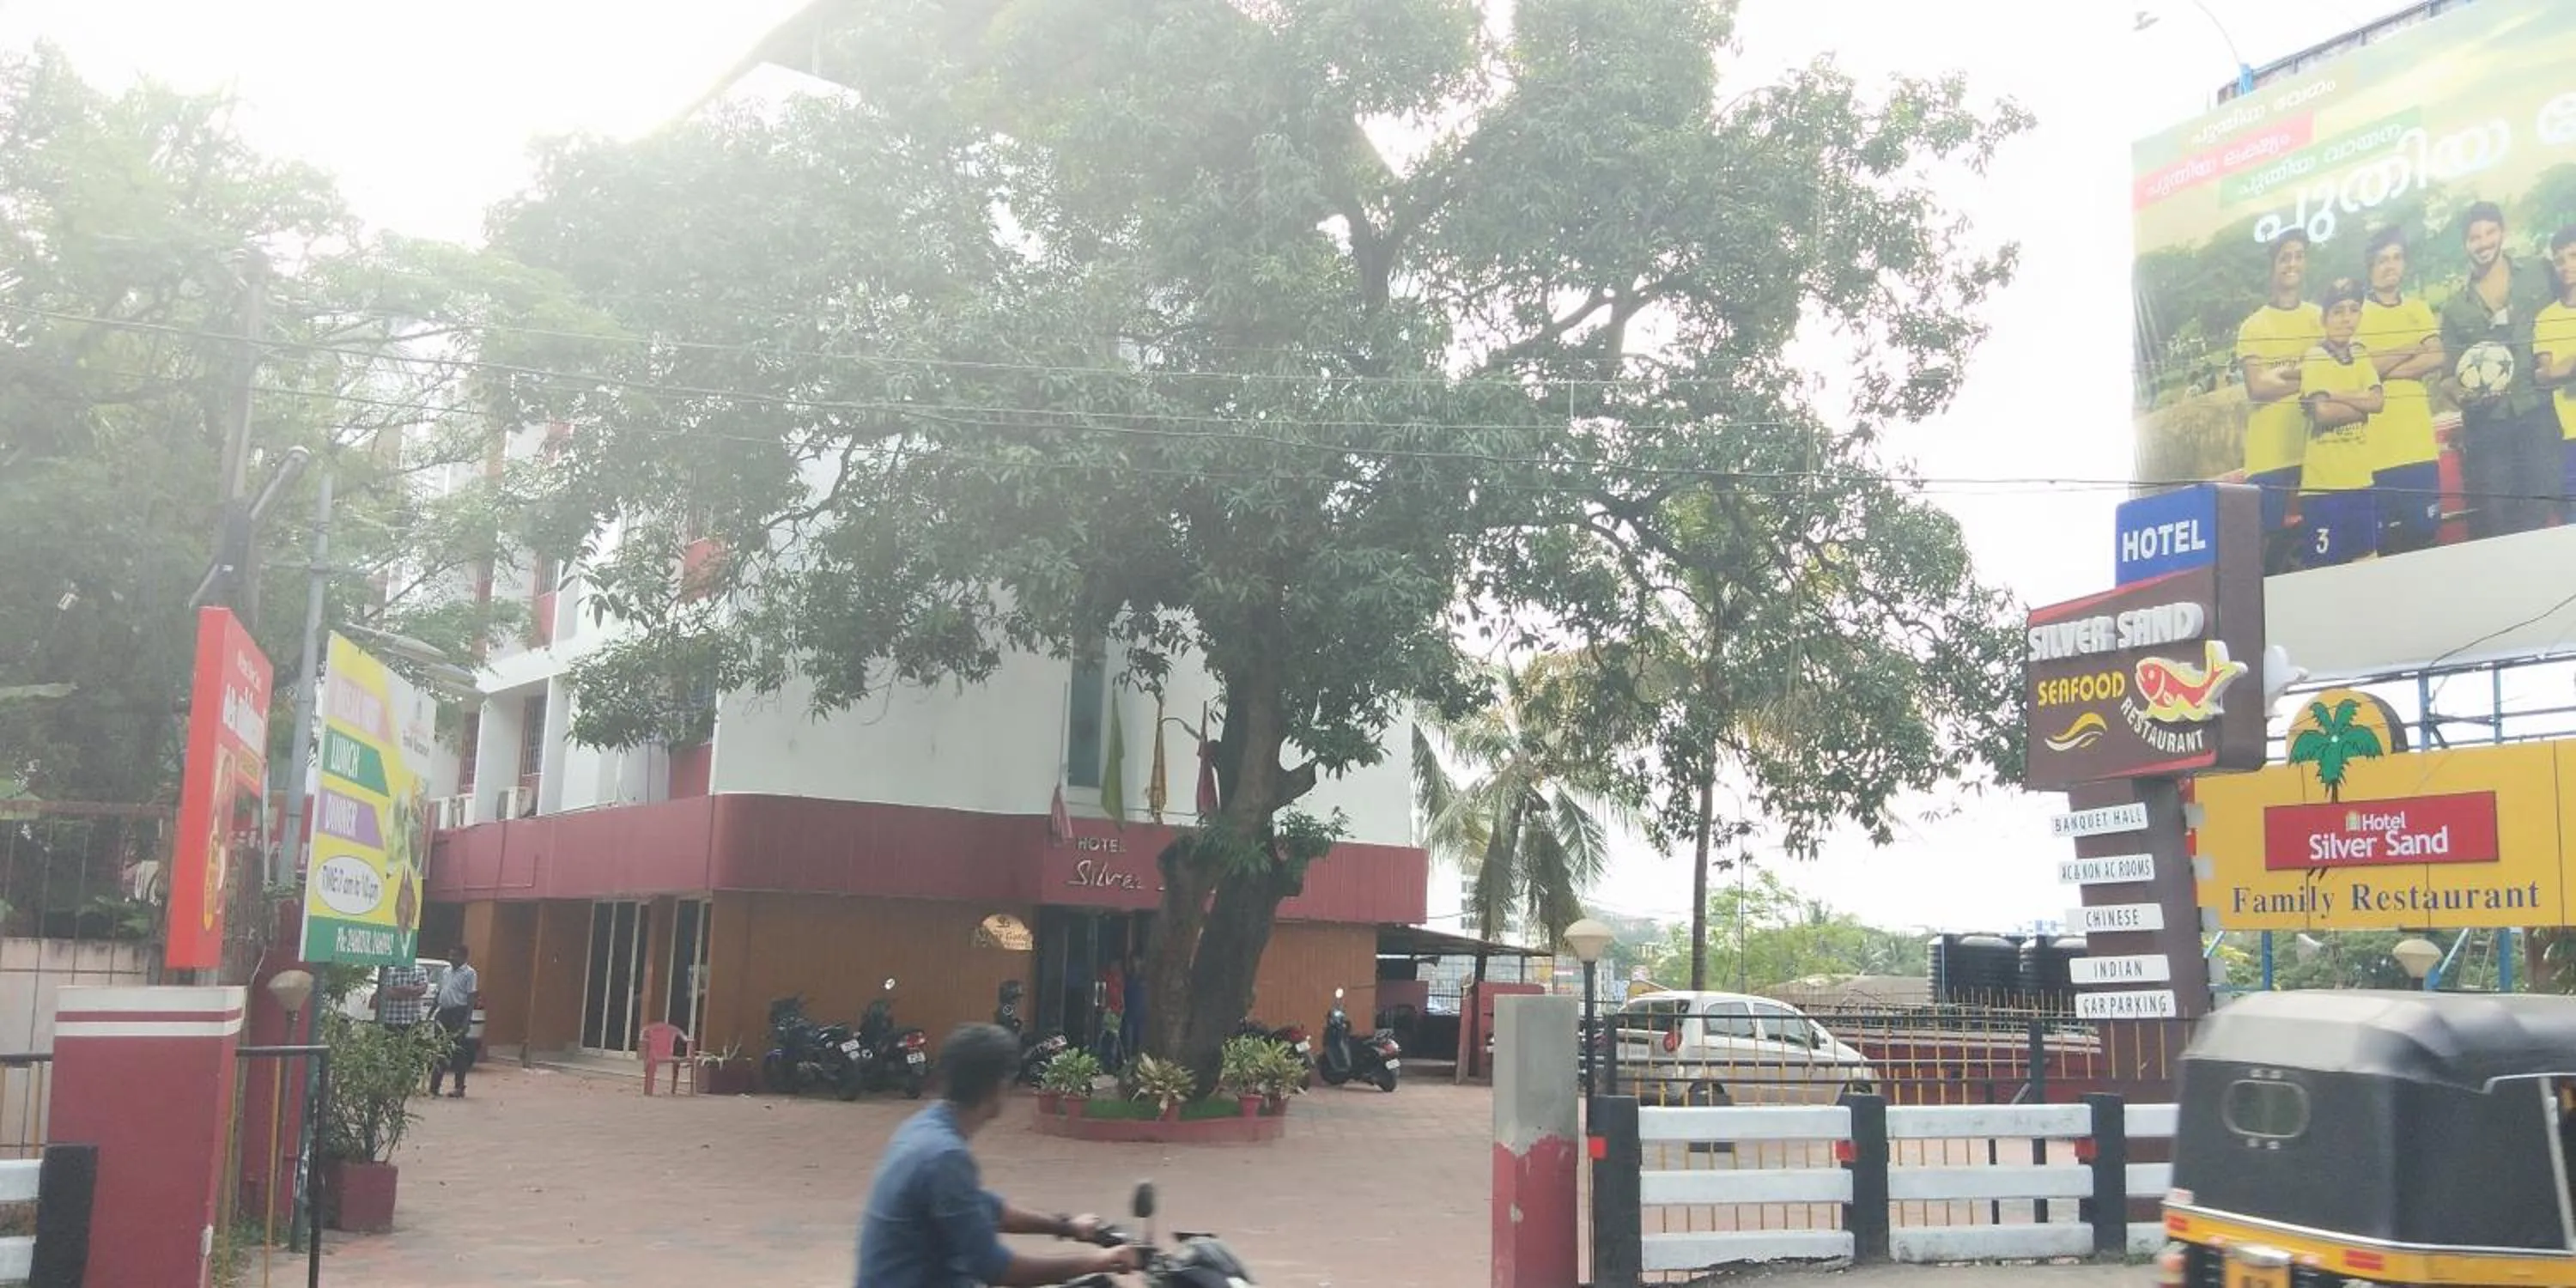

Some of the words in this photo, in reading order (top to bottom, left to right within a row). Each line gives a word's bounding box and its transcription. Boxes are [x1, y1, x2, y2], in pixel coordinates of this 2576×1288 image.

[2147, 157, 2217, 196] പുതിയ
[2239, 155, 2317, 194] പുതിയ
[2253, 118, 2512, 244] പുതിയ
[2122, 520, 2206, 562] HOTEL
[2316, 528, 2330, 554] 3
[2028, 616, 2117, 662] SILVER
[2117, 602, 2204, 648] SAND
[2038, 671, 2125, 706] SEAFOOD
[2120, 696, 2204, 753] RESTAURANT
[2055, 811, 2107, 832] BANQUET
[2113, 808, 2142, 824] HALL
[2361, 811, 2406, 832] Hotel
[2309, 831, 2378, 860] Silver
[2385, 826, 2448, 857] Sand
[2118, 859, 2150, 877] ROOMS
[2233, 885, 2336, 919] Family
[2351, 880, 2541, 912] Restaurant
[2086, 911, 2139, 927] CHINESE
[2093, 960, 2142, 978] INDIAN
[2084, 998, 2105, 1015] CAR
[2109, 994, 2167, 1015] PARKING
